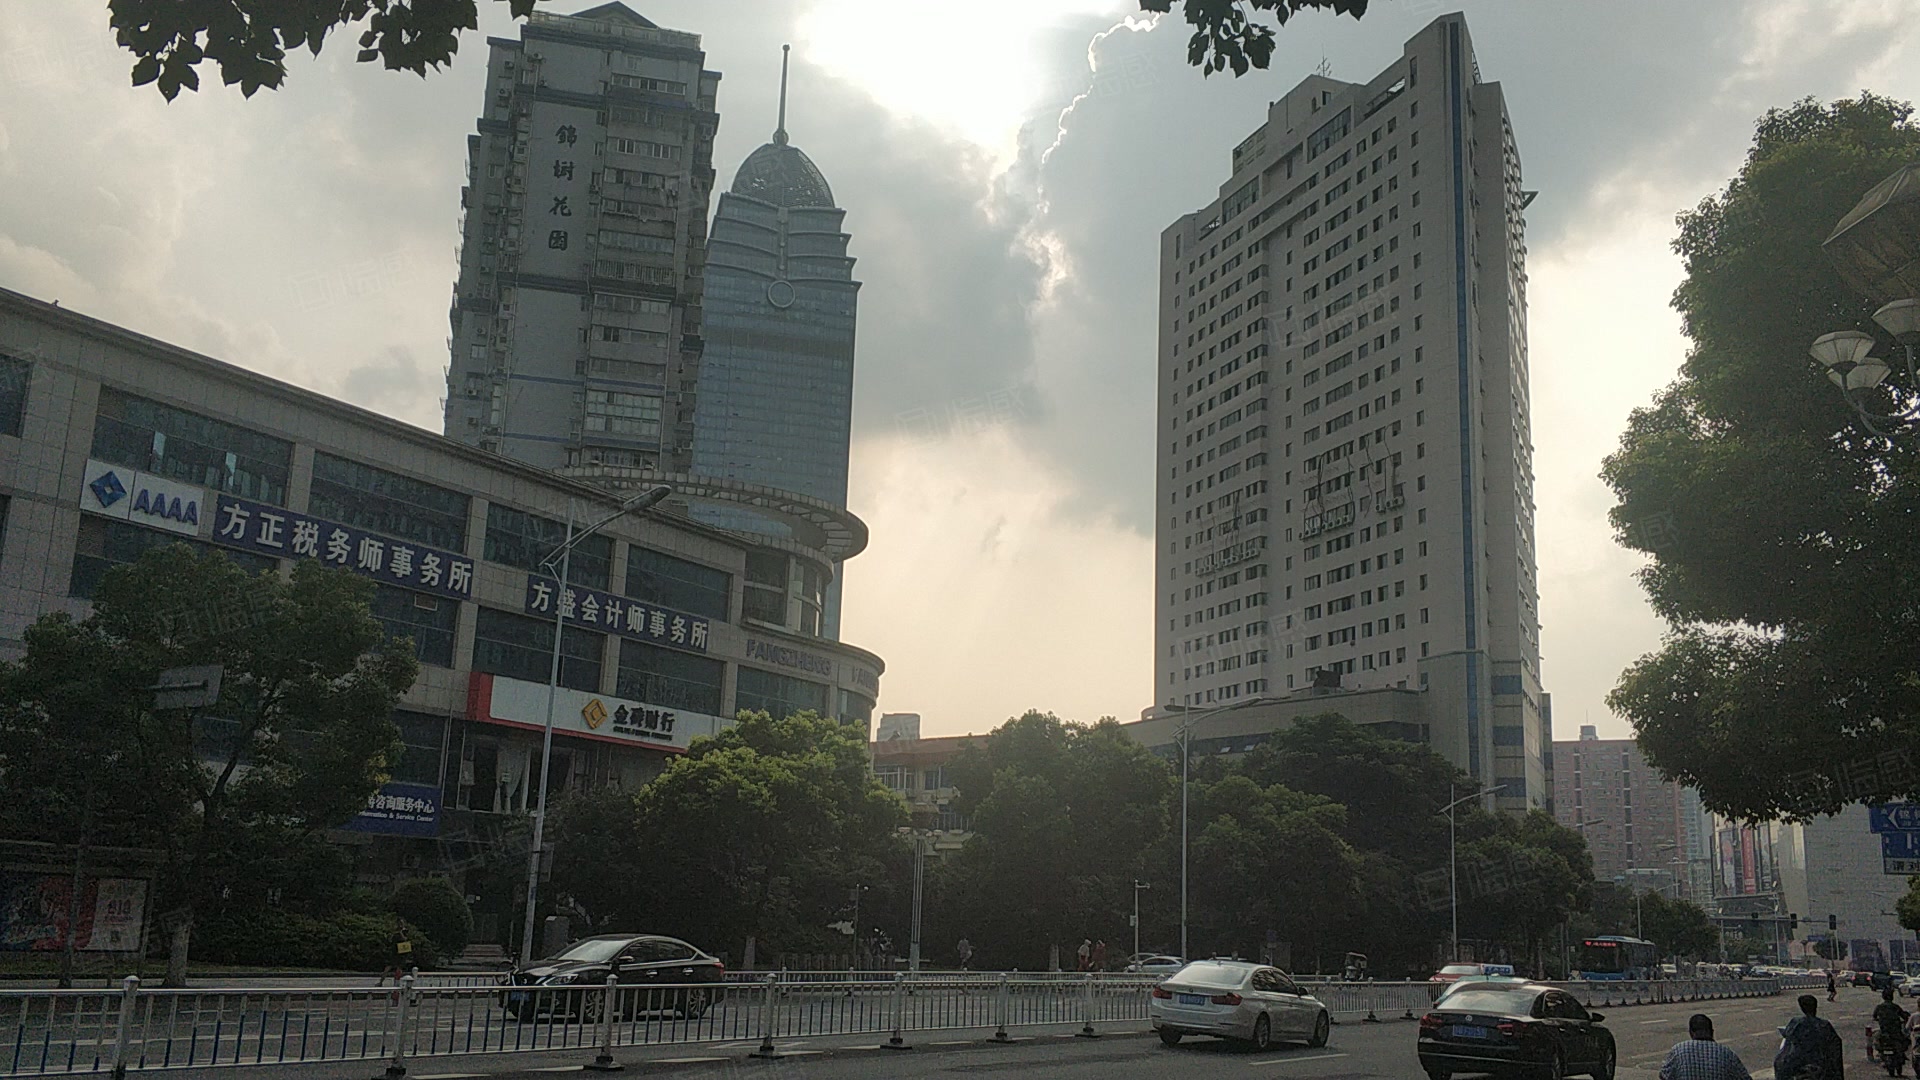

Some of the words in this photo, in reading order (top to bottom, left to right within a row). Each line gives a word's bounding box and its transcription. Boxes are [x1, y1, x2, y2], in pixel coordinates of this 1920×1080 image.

[133, 488, 198, 526] AAAA
[220, 502, 474, 595] 方正税务师事务所
[531, 581, 708, 649] 方盛会计师事务所
[746, 639, 832, 676] FANGZHENG
